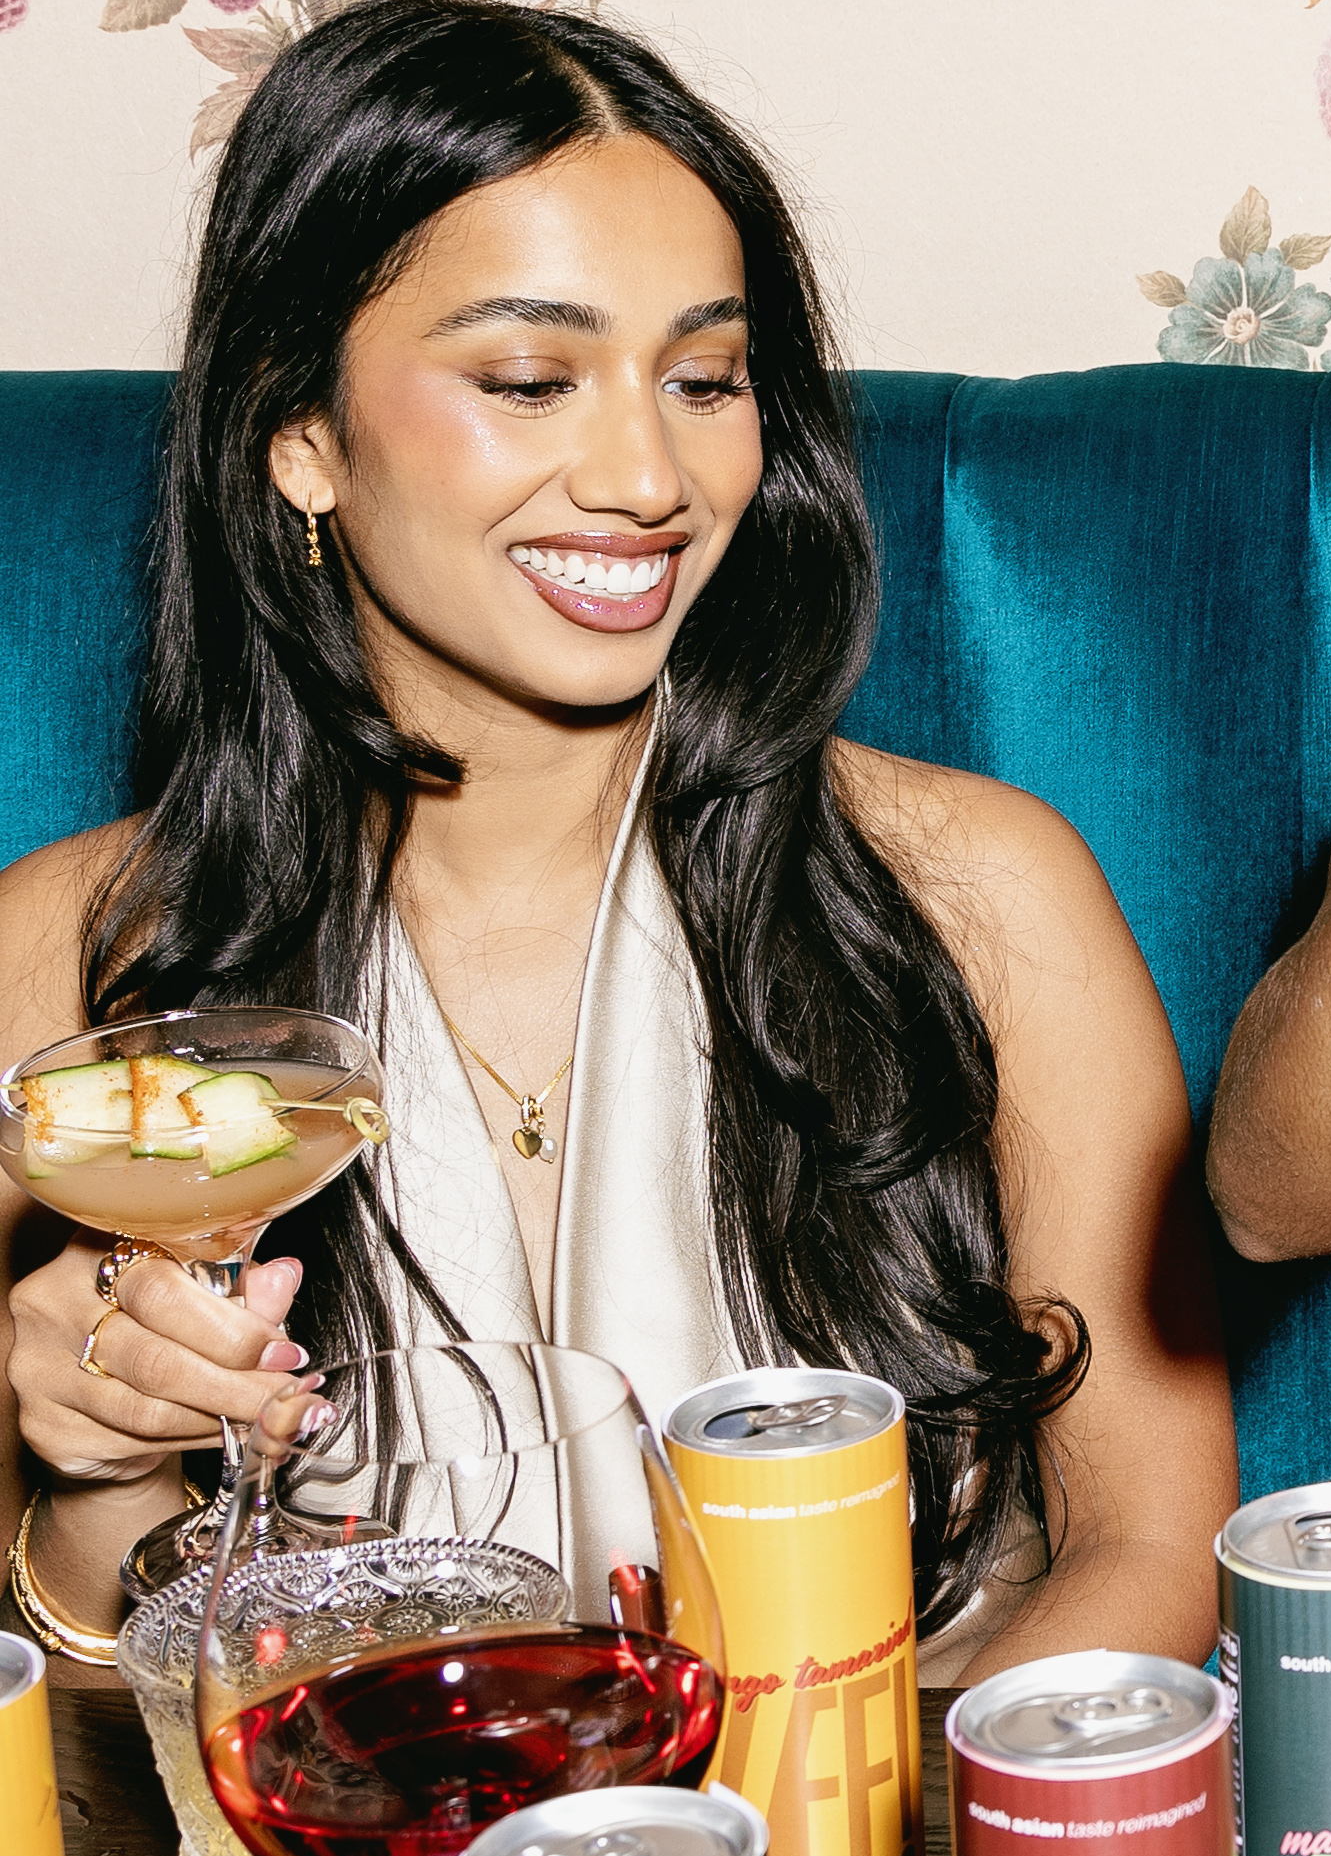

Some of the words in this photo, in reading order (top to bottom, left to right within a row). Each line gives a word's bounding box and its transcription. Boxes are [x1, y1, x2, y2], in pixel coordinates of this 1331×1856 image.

[702, 1501, 746, 1519] south
[747, 1505, 797, 1520] asian
[798, 1499, 838, 1516] taste
[793, 1596, 914, 1689] tamarind
[1279, 1654, 1331, 1674] south
[967, 1800, 1010, 1831] south
[1011, 1813, 1065, 1839] asian
[1066, 1818, 1115, 1839] taste
[1116, 1791, 1208, 1835] reimagined
